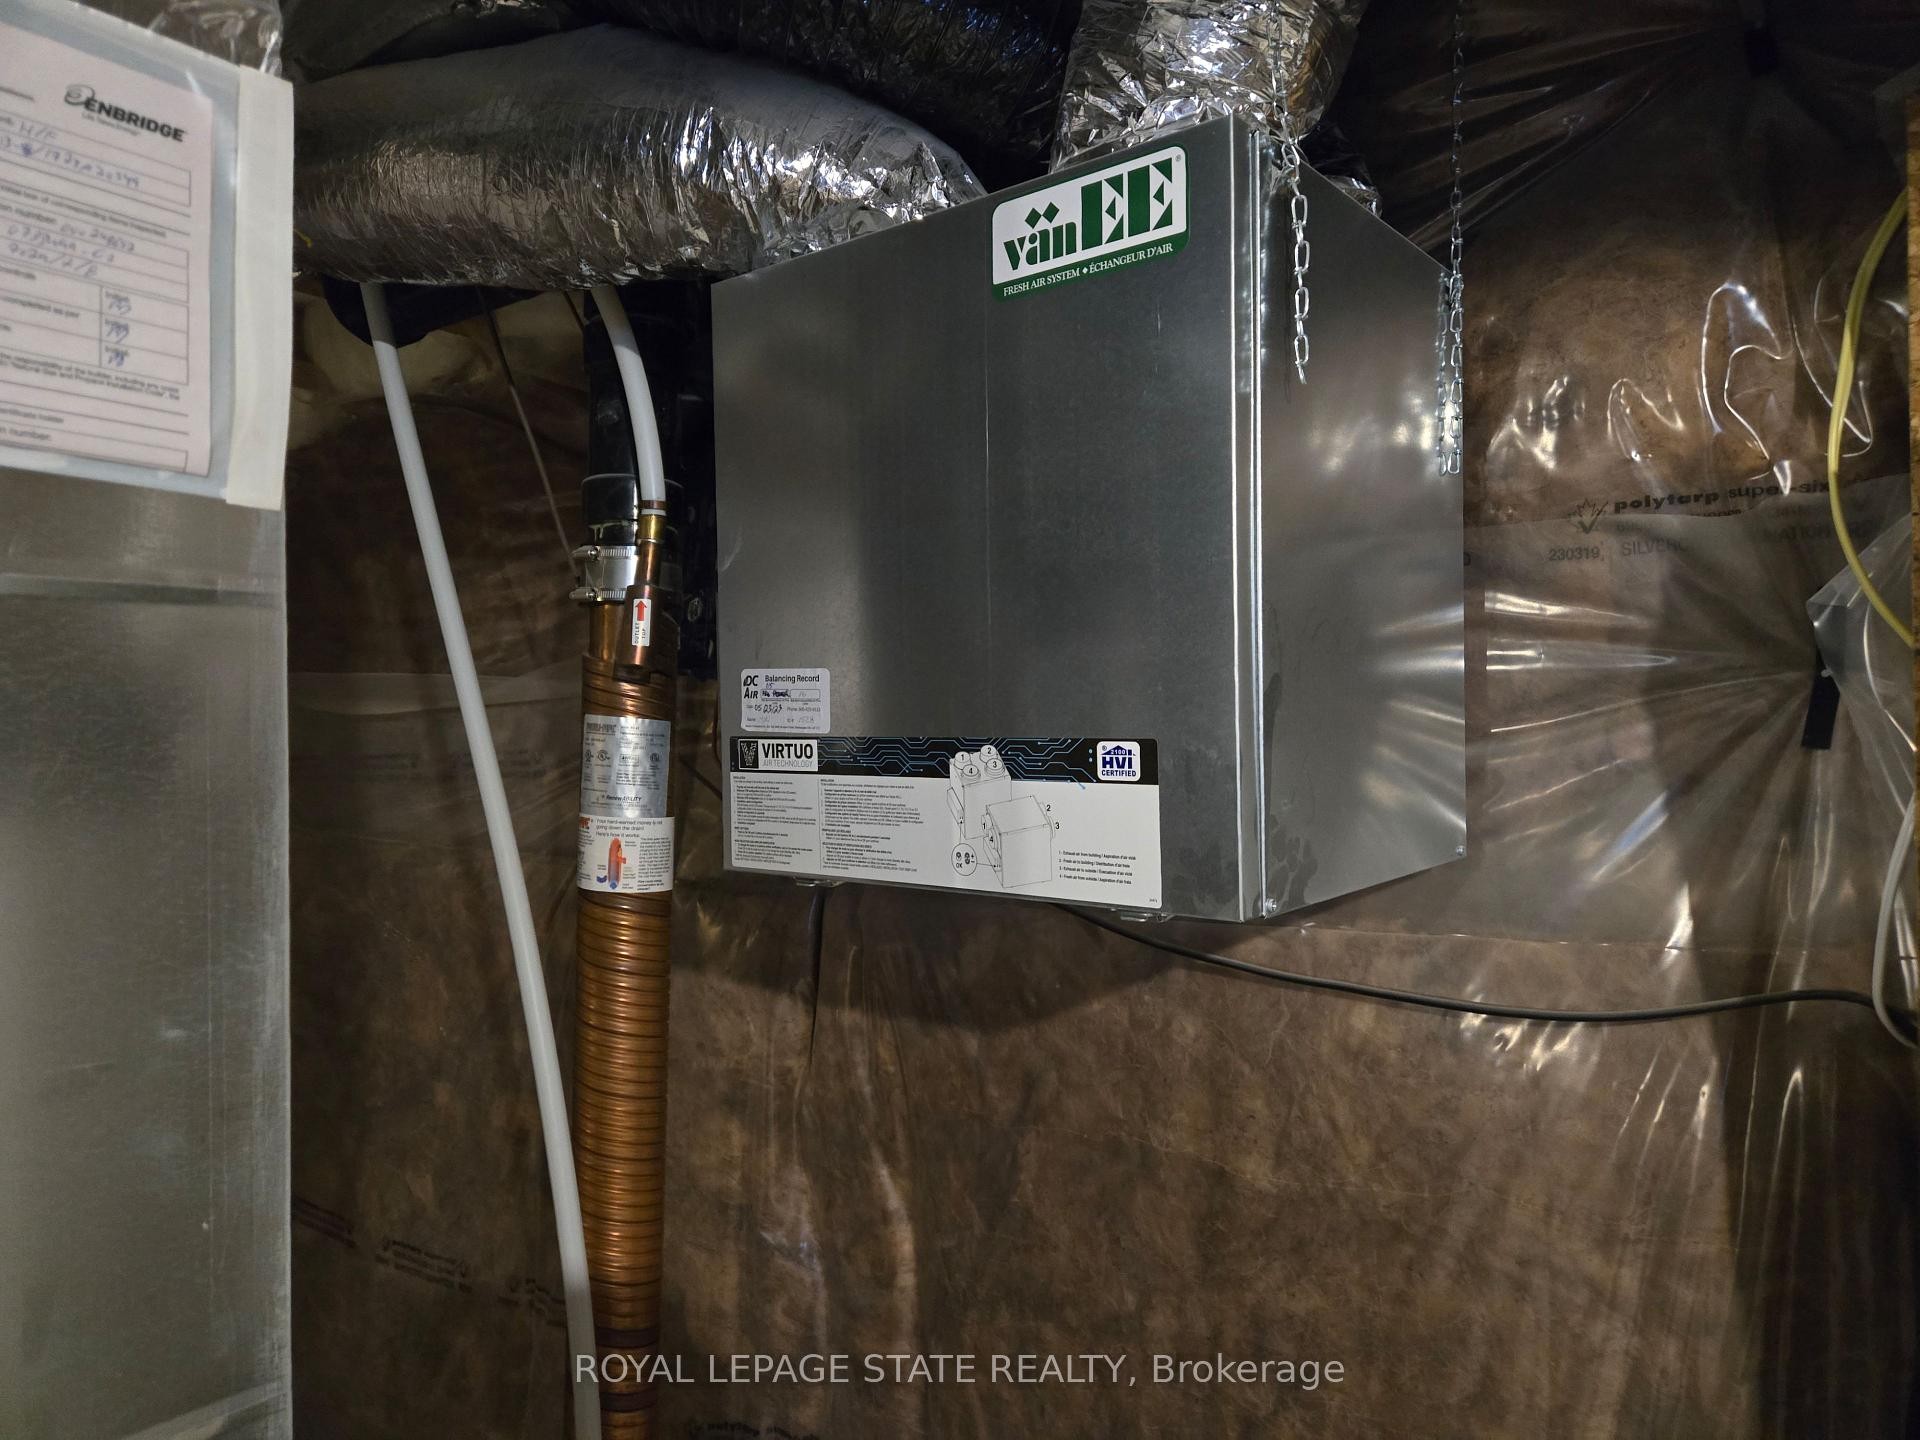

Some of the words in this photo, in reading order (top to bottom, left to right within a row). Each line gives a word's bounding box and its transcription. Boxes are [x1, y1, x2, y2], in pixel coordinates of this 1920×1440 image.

[85, 97, 186, 143] ENBRIDGE
[1003, 281, 1030, 296] FRESH
[1031, 277, 1046, 290] AIR
[1047, 267, 1081, 285] SYSTEM
[1089, 250, 1146, 274] ÉCHANGEUR
[1147, 242, 1174, 259] D'AIR
[1614, 491, 1720, 513] polytarp
[765, 675, 796, 684] Balancing
[762, 743, 813, 759] VIRTUO
[986, 747, 992, 755] 2
[1102, 749, 1133, 769] HVI
[774, 760, 813, 768] TECHNOLOGY
[992, 760, 998, 768] 3
[968, 767, 974, 775] 4
[1101, 769, 1137, 777] CERTIFIED
[1046, 804, 1052, 812] 2
[1055, 821, 1060, 829] 3
